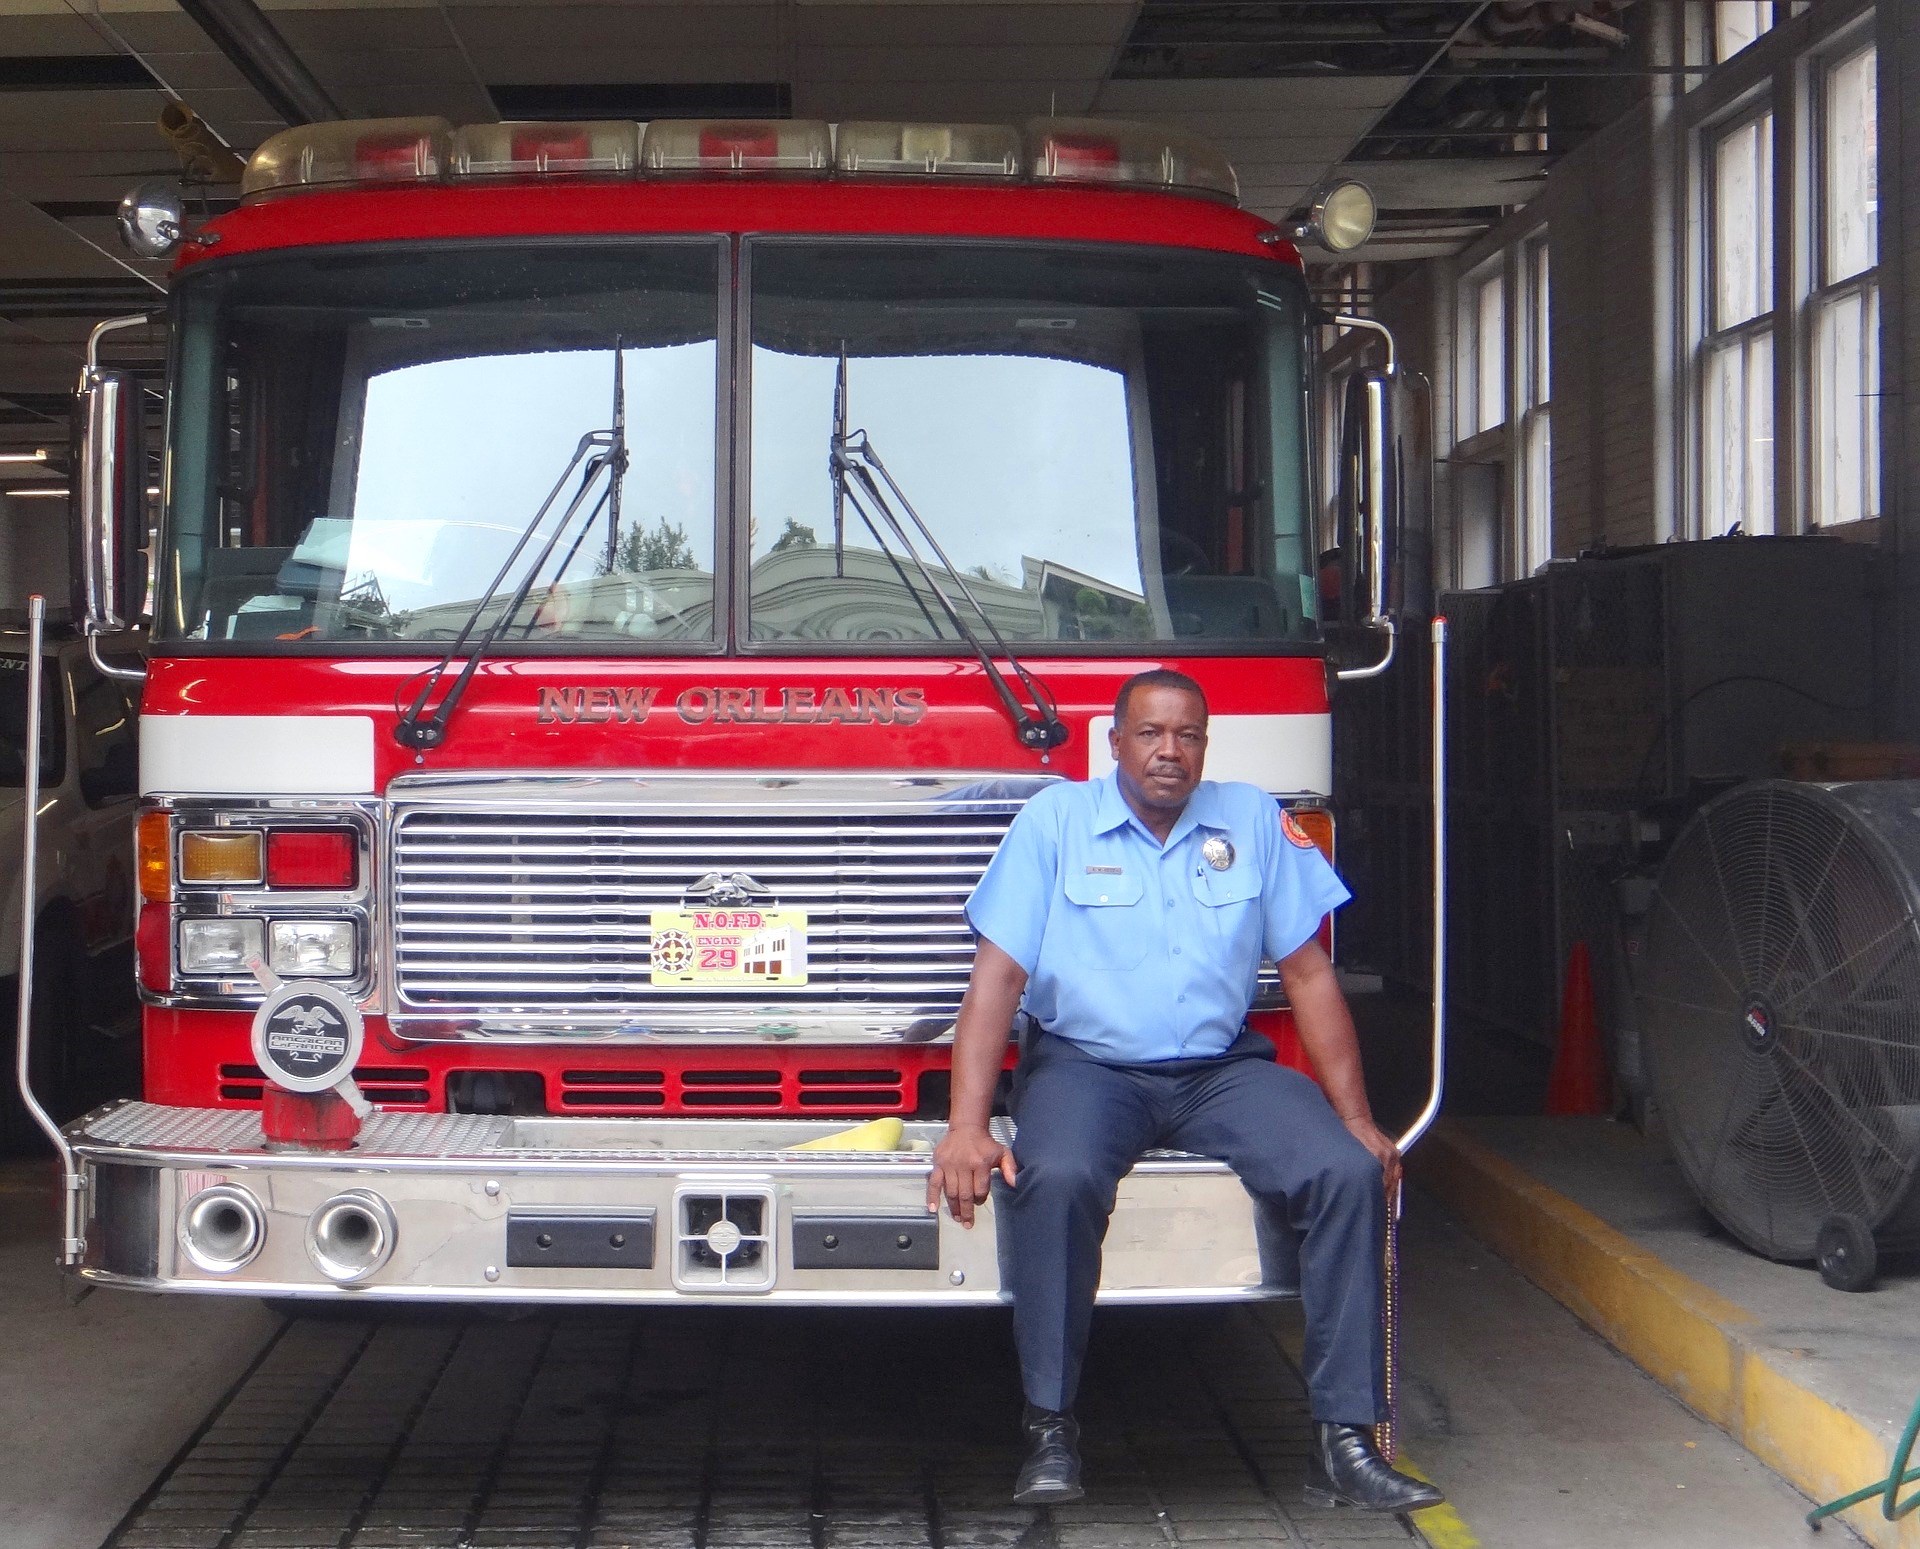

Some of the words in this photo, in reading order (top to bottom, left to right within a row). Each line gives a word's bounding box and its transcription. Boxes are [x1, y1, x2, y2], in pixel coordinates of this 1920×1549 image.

[537, 687, 660, 726] NEW
[677, 687, 928, 726] ORLEANS
[694, 911, 766, 930] N.O.F.D.
[696, 936, 741, 947] ENGINE
[699, 948, 739, 971] 29
